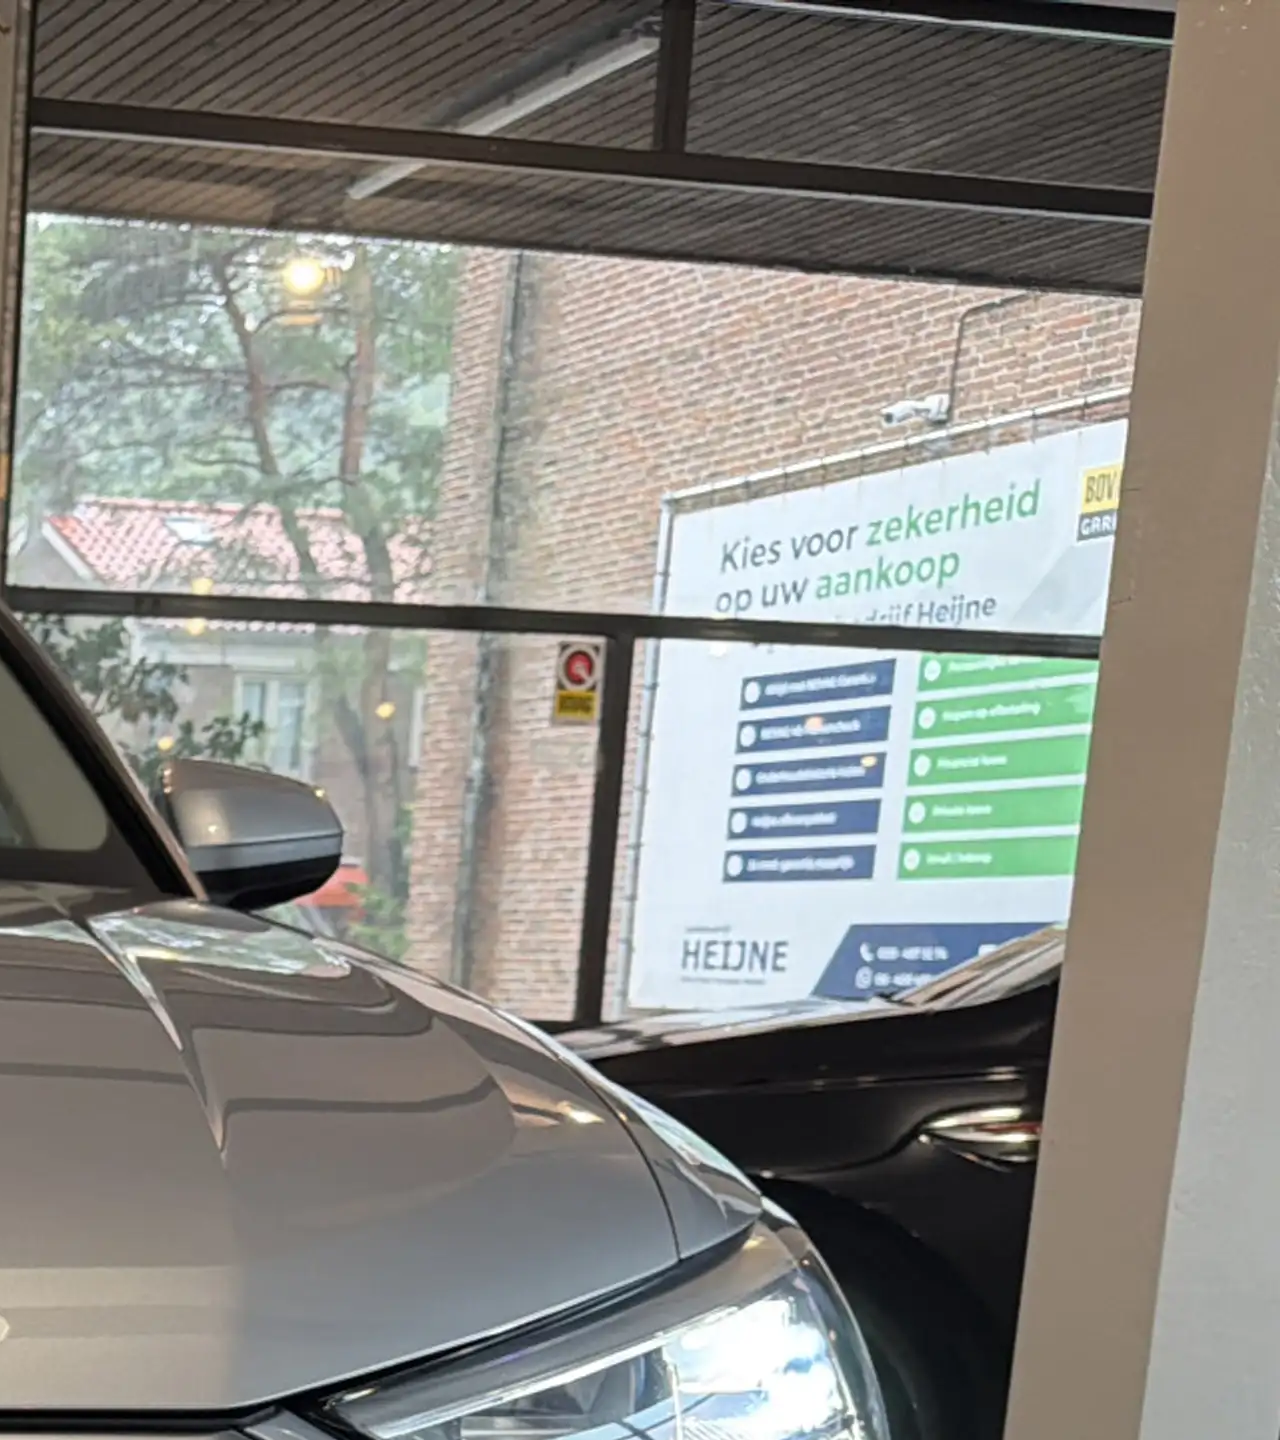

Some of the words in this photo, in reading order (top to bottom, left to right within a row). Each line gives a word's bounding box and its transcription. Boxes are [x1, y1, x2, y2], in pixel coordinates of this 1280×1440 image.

[1085, 470, 1120, 504] BOV
[720, 536, 781, 573] Kies
[791, 525, 859, 560] voor
[865, 478, 1041, 546] zekerheid
[716, 588, 752, 617] op
[761, 577, 810, 608] uw
[815, 552, 960, 600] aankoop
[917, 594, 997, 625] Heijne
[682, 939, 789, 972] HEIJNE
